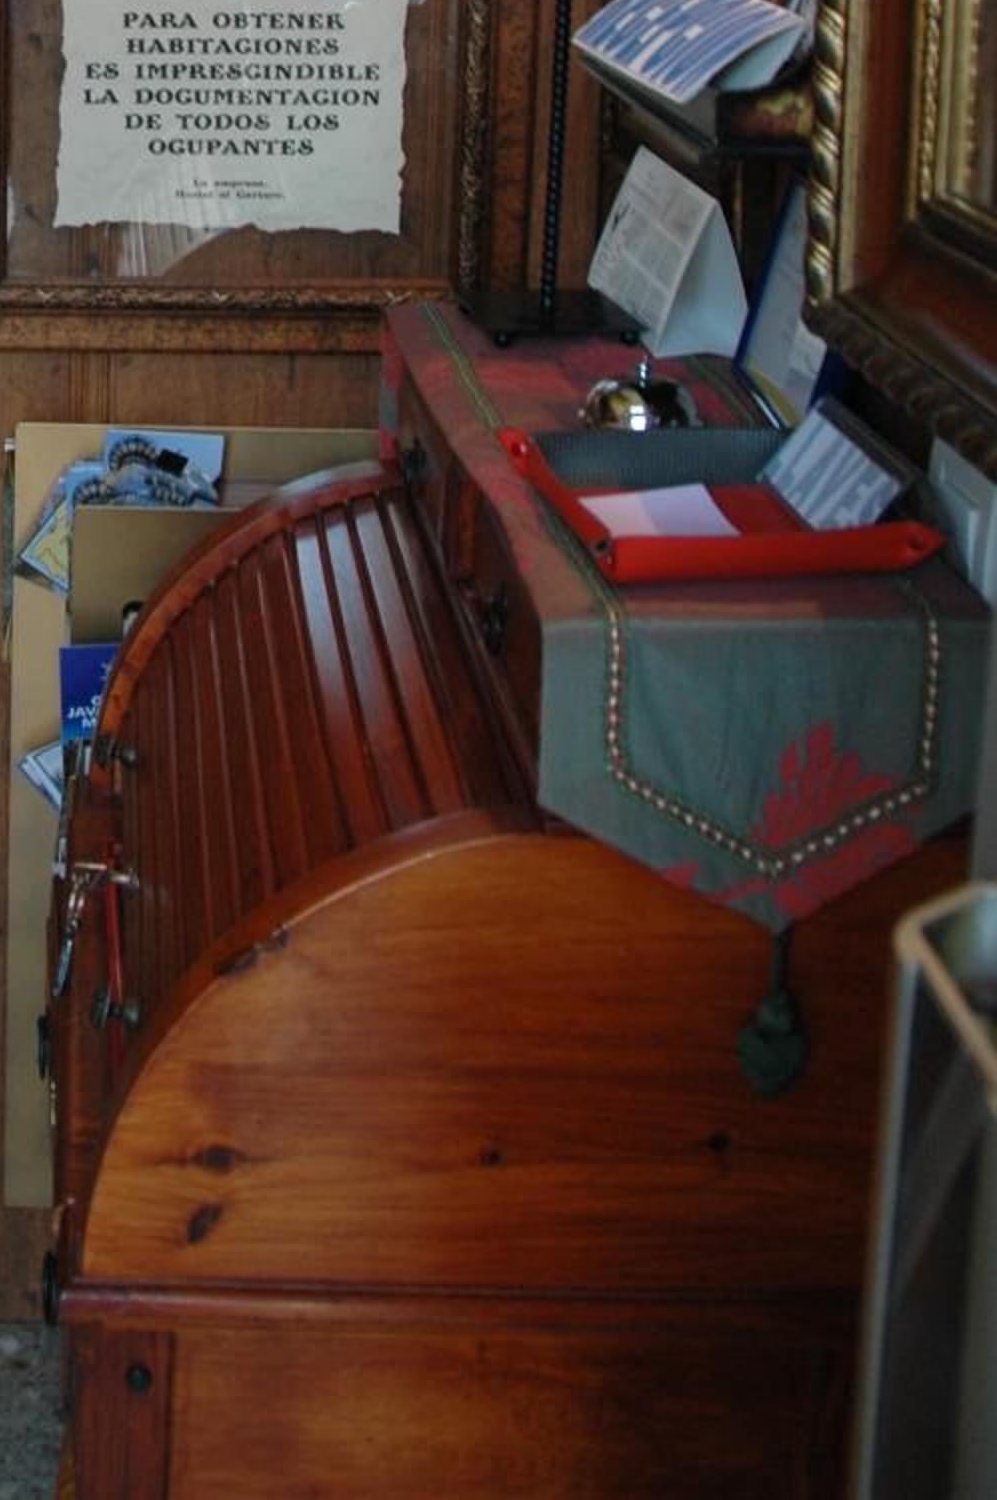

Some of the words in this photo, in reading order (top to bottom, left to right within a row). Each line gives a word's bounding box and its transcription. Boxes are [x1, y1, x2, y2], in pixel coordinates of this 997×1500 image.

[122, 12, 198, 29] PARA
[212, 11, 345, 30] OBTENER
[85, 62, 119, 80] ES
[84, 88, 119, 105] LA
[125, 113, 162, 130] DE
[179, 113, 271, 131] TODOS
[287, 113, 340, 130] LOS
